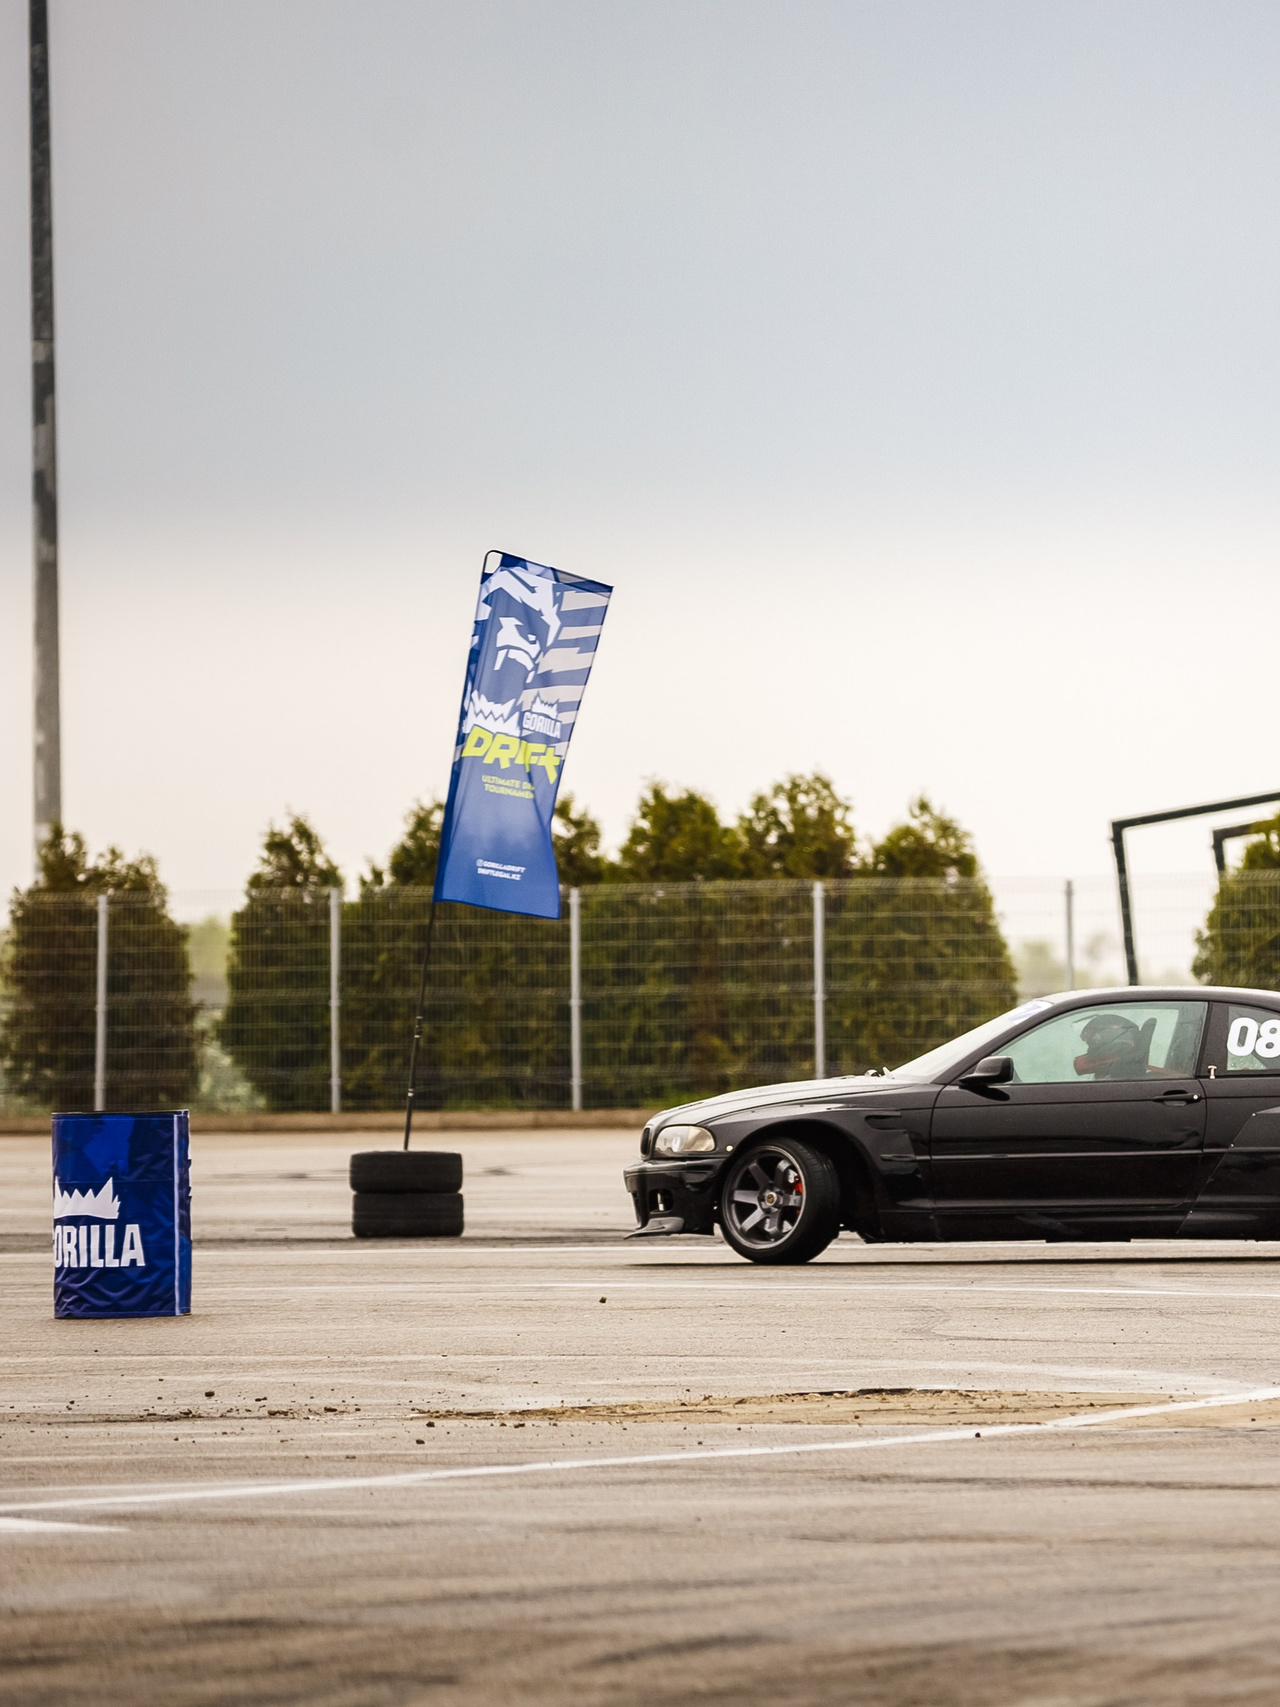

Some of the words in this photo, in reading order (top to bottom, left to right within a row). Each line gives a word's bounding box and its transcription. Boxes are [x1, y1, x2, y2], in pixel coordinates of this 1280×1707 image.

[522, 711, 562, 739] GORILLA
[461, 725, 561, 784] DRIFT
[481, 775, 521, 788] ULTIMATE
[54, 1223, 146, 1268] ORILLA
